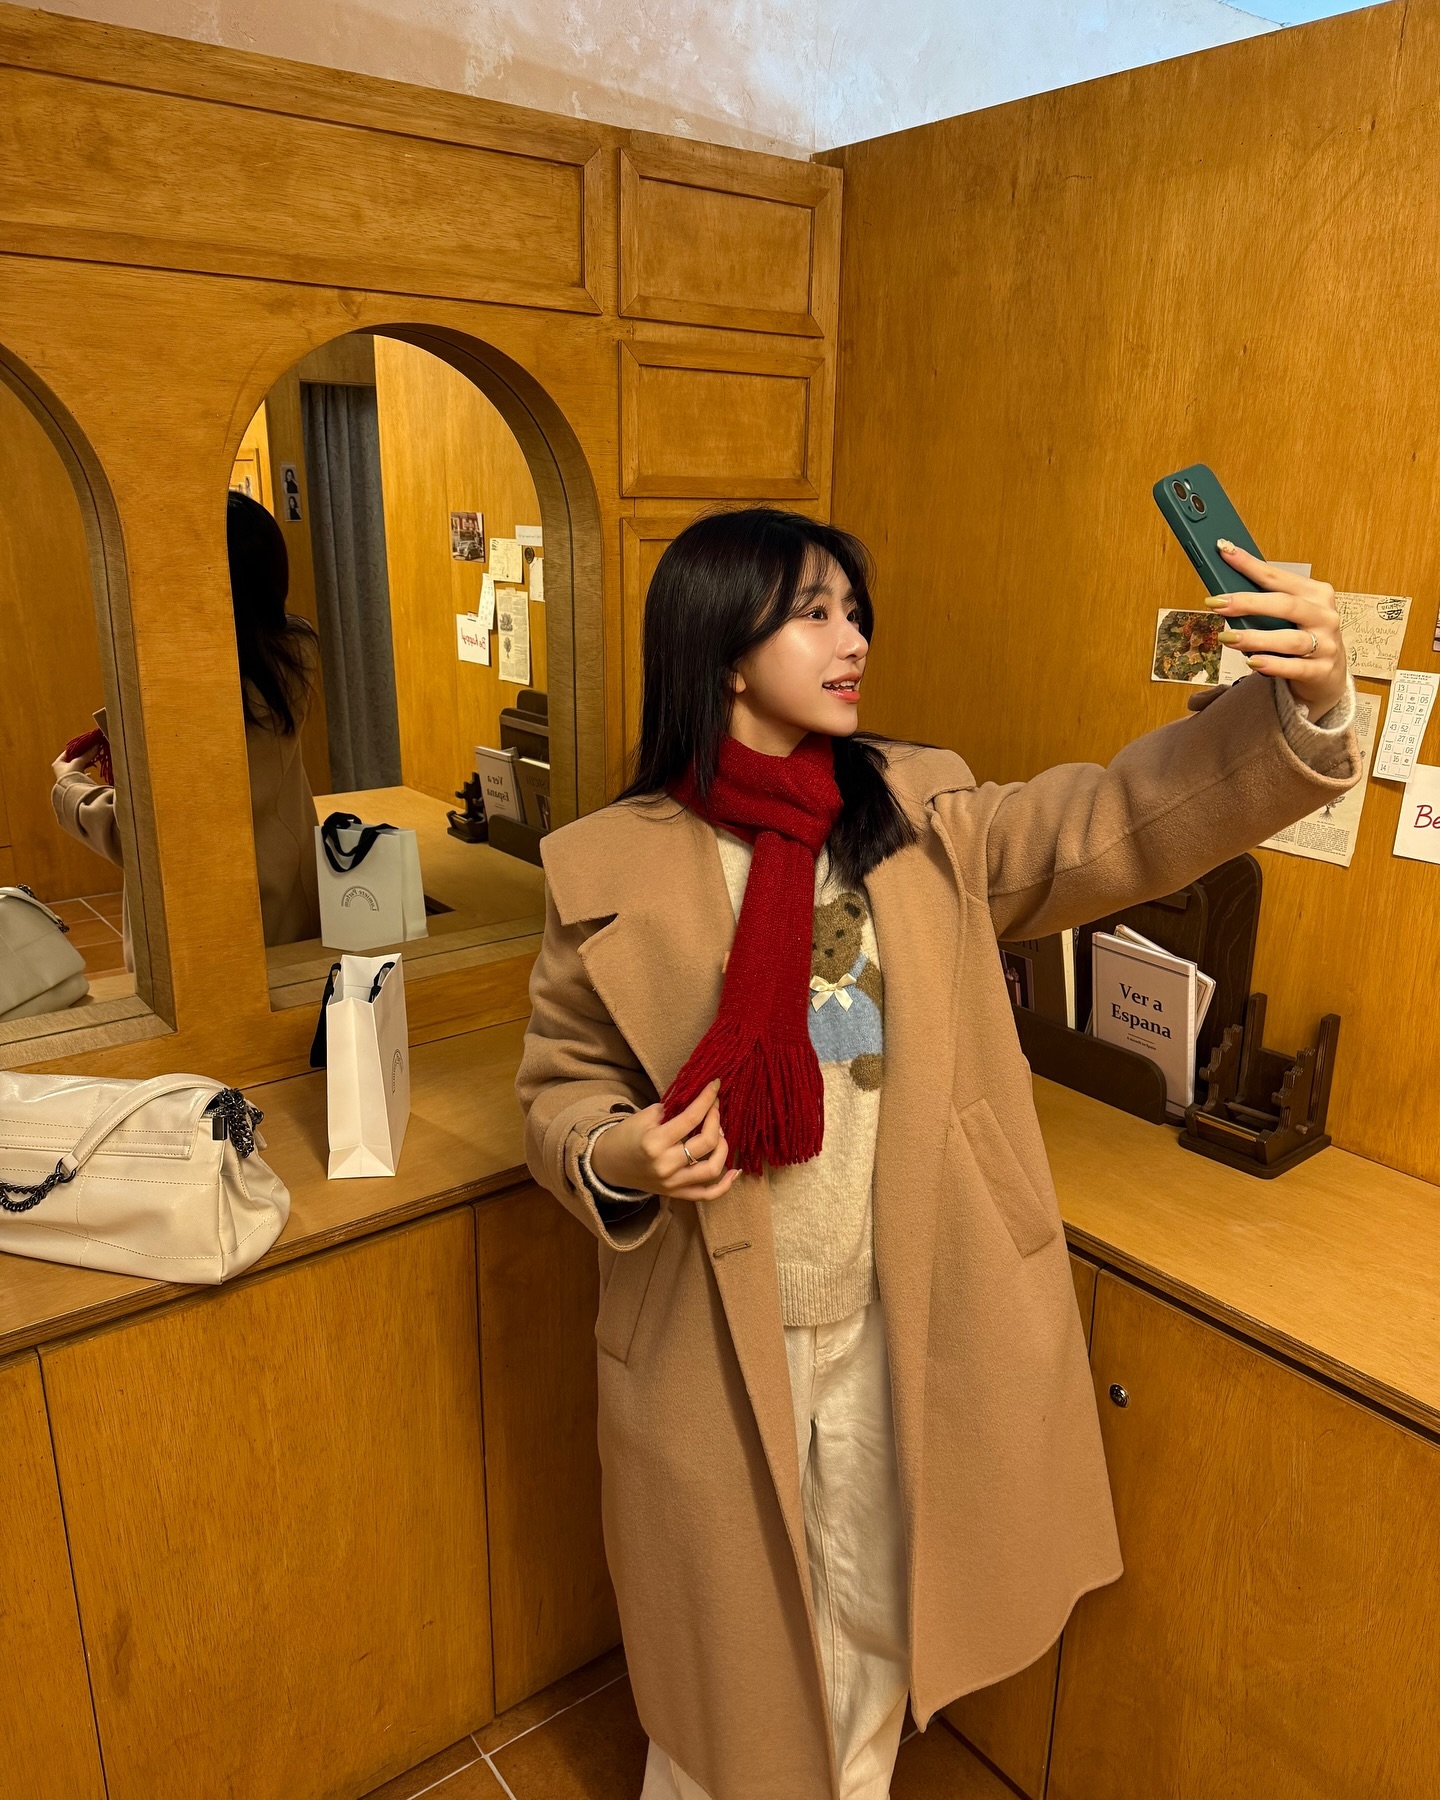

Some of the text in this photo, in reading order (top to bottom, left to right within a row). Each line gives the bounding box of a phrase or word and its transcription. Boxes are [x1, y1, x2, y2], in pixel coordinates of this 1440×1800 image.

[1414, 805, 1440, 829] Be
[1119, 982, 1163, 1012] Ver a
[1111, 1002, 1172, 1039] Espana
